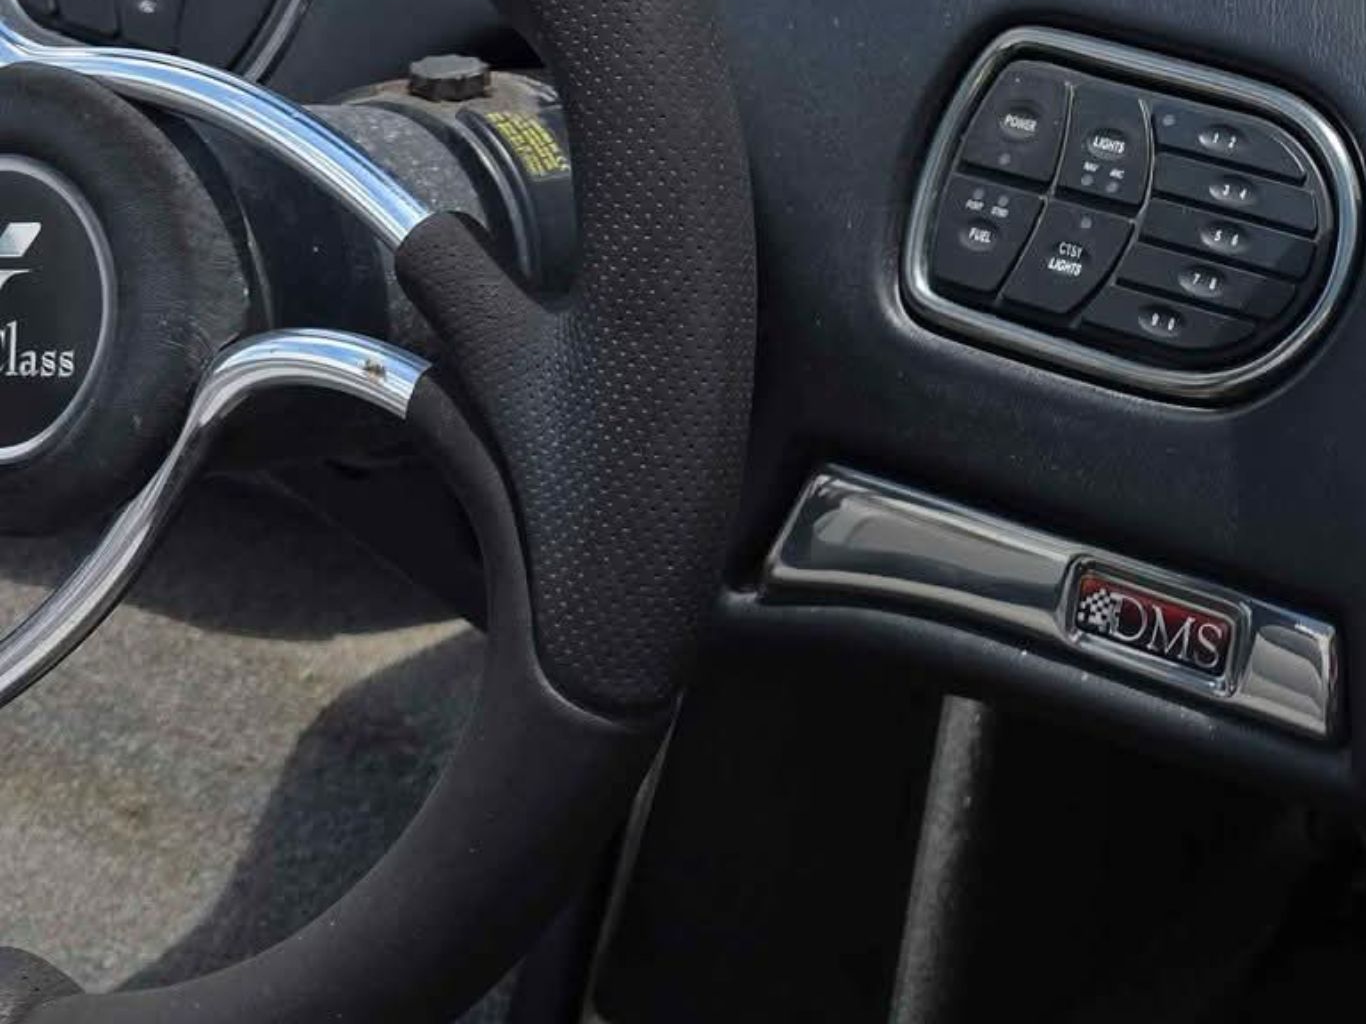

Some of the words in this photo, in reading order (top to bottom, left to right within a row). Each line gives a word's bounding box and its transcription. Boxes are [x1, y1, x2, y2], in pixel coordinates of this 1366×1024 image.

[1003, 113, 1038, 133] POWER
[1092, 136, 1126, 154] LIGHTS
[967, 226, 992, 244] FUEL
[1048, 257, 1082, 277] LIGHTS
[1108, 591, 1223, 669] DMS
